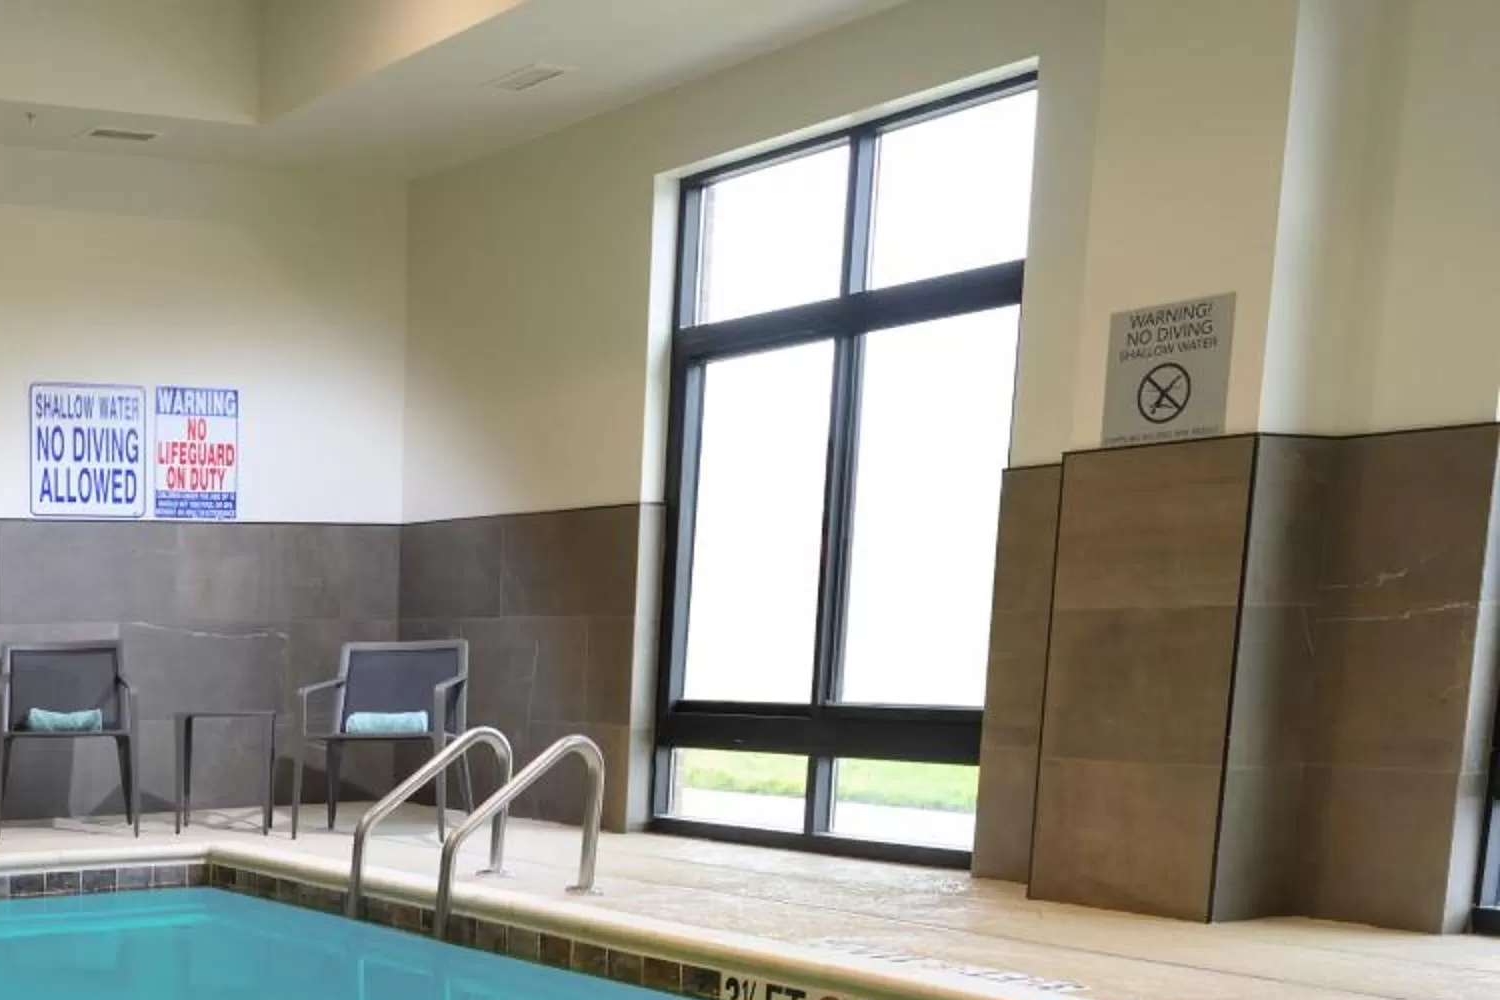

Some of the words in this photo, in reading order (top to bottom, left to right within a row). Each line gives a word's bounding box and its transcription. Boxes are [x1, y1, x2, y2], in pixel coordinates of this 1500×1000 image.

[1129, 303, 1214, 330] WARNING!
[1126, 329, 1153, 347] NO
[1157, 319, 1214, 343] DIVING
[35, 394, 95, 420] SHALLOW
[99, 396, 140, 421] WATER
[158, 388, 236, 416] WARNING
[187, 418, 208, 441] NO
[37, 425, 65, 462] NO
[73, 426, 139, 465] DIVING
[157, 442, 235, 466] LIFEGUARD
[39, 467, 138, 505] ALLOWED
[166, 466, 185, 490] ON
[190, 468, 226, 491] DUTY
